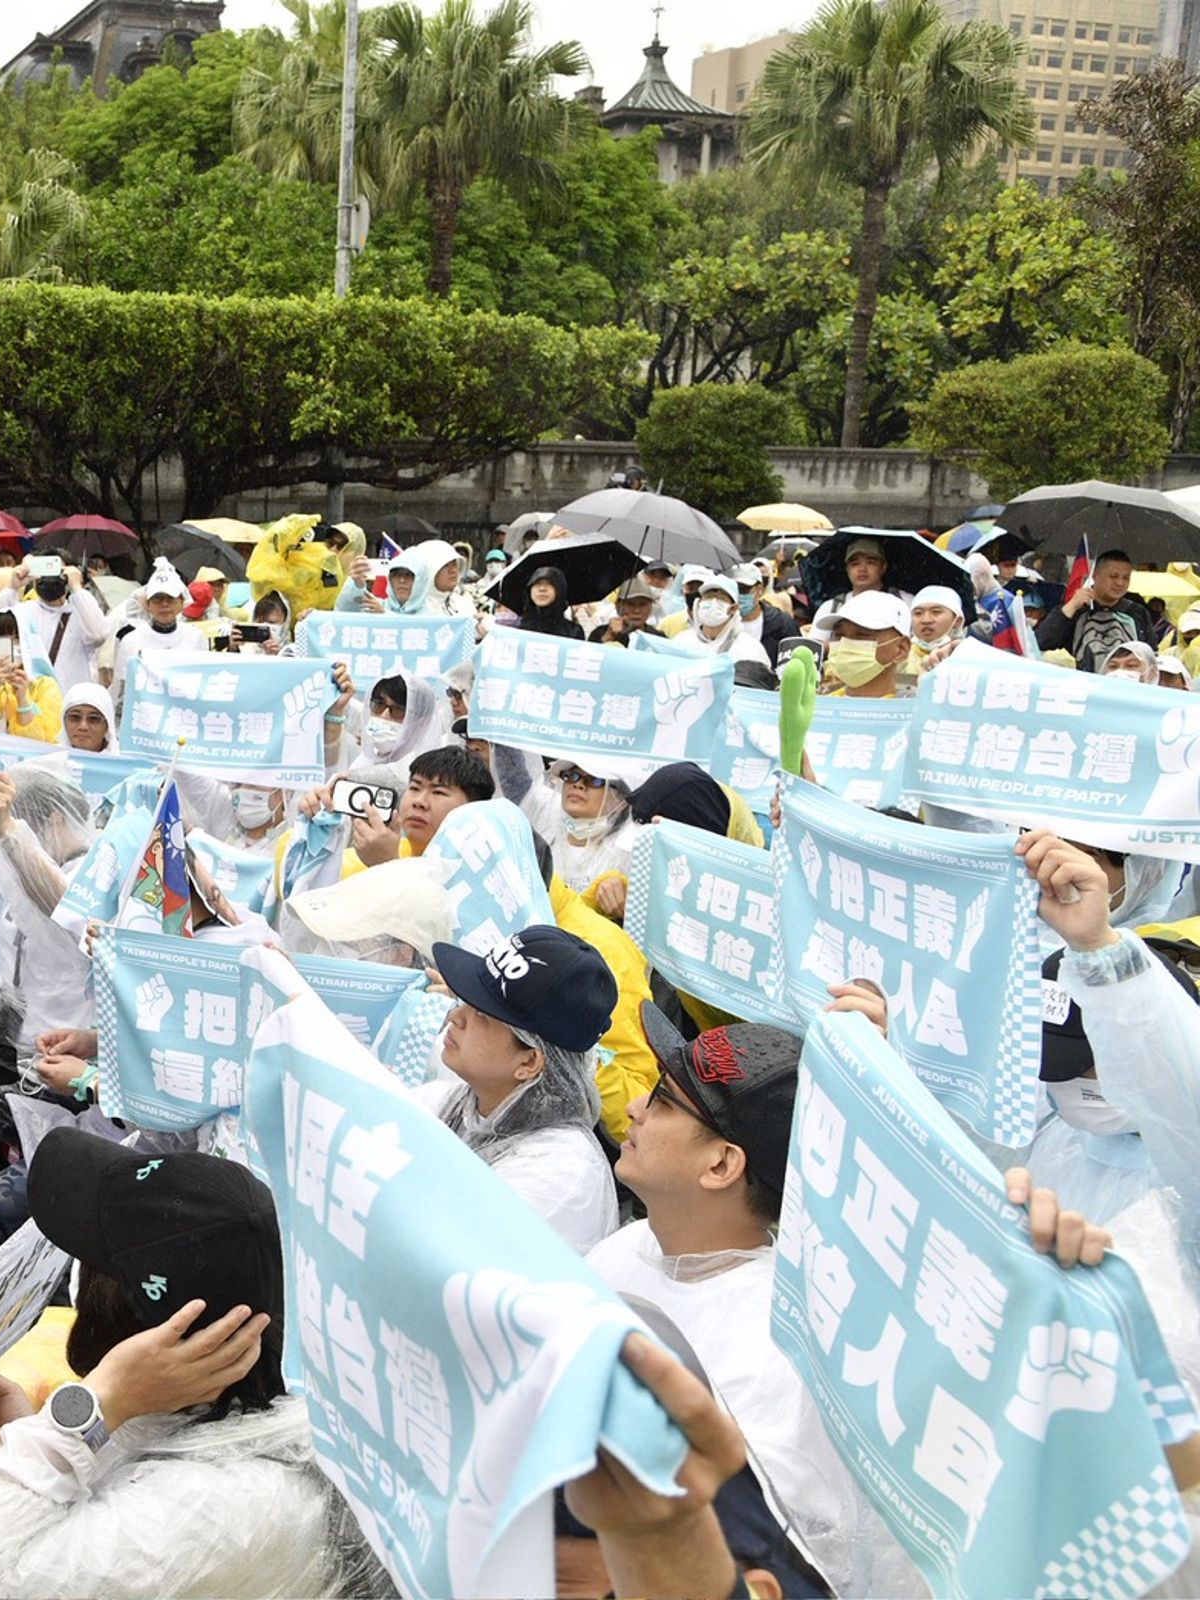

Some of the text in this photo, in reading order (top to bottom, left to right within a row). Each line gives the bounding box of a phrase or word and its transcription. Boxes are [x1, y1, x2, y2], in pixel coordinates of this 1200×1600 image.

[341, 626, 429, 650] 把正義
[483, 636, 604, 682] 把民主
[477, 677, 642, 731] 還給台灣
[931, 668, 1089, 717] 把民主
[132, 701, 274, 745] 還給台灣
[519, 722, 590, 742] PEOPLE'S
[590, 732, 637, 747] PARTY
[131, 735, 169, 750] TAIWAN
[231, 748, 267, 760] PARTY
[918, 719, 1139, 785] 還給台灣
[276, 772, 324, 783] JUSTIC
[917, 769, 1129, 807] TAIWAN PEOPLE'S PARTY
[1128, 831, 1200, 845] JUSTI
[828, 850, 958, 961] 把正義
[121, 945, 160, 961] TAIWAN
[160, 952, 208, 968] PEOPLE'S
[306, 975, 350, 988] TAIWAN
[184, 988, 238, 1046] 把
[826, 1032, 1002, 1213] PARTY JUSTICE TAIWAN
[798, 1062, 1009, 1382] 把正義
[856, 1445, 912, 1524] TAIWAN
